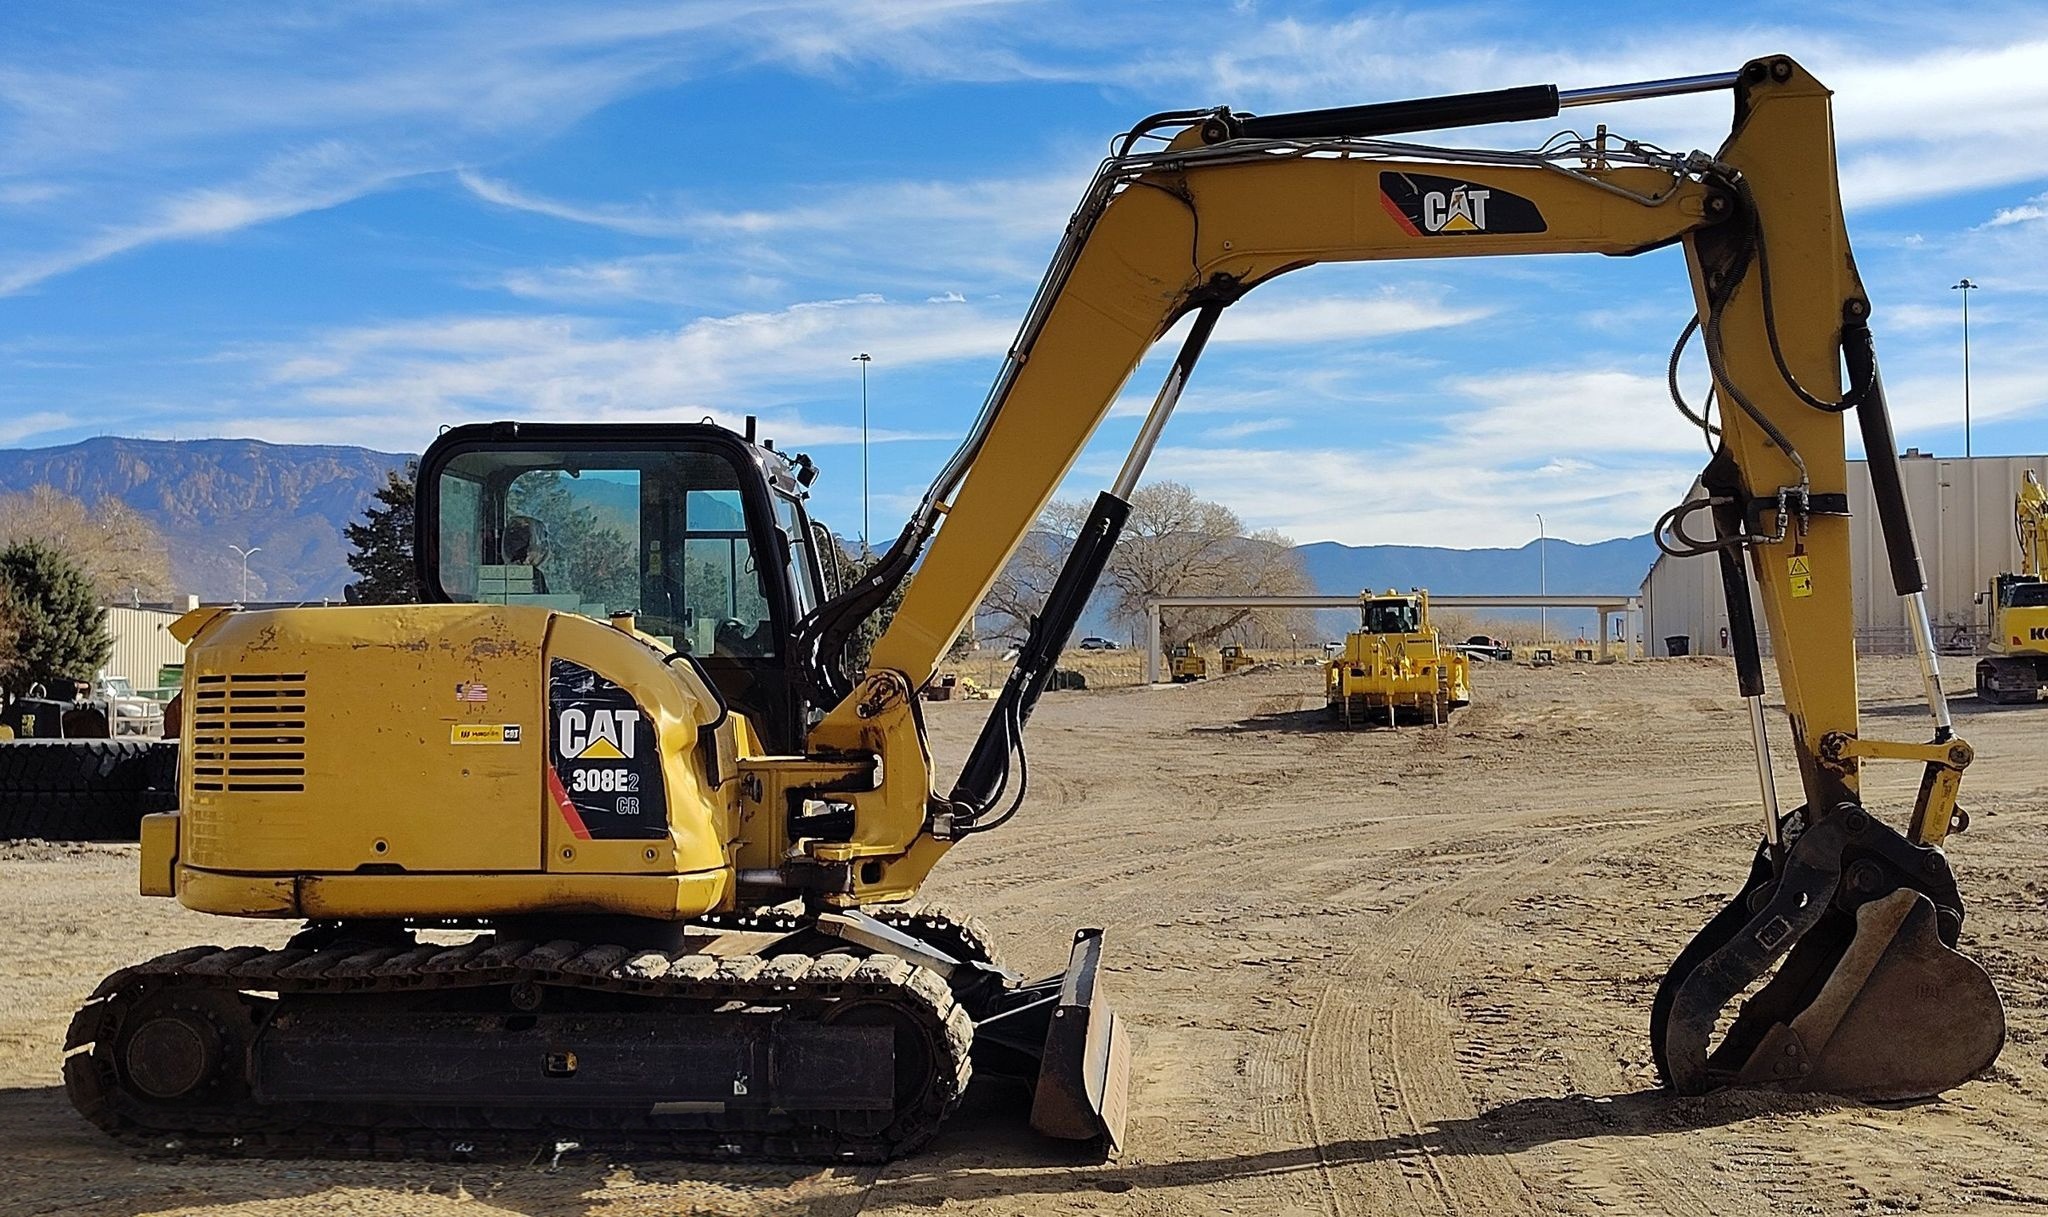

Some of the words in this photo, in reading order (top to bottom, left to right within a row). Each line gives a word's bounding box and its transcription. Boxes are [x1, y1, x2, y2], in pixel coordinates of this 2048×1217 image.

[1424, 190, 1490, 232] CAT
[560, 709, 640, 759] CAT
[572, 768, 640, 792] 308E2
[616, 796, 640, 815] CR
